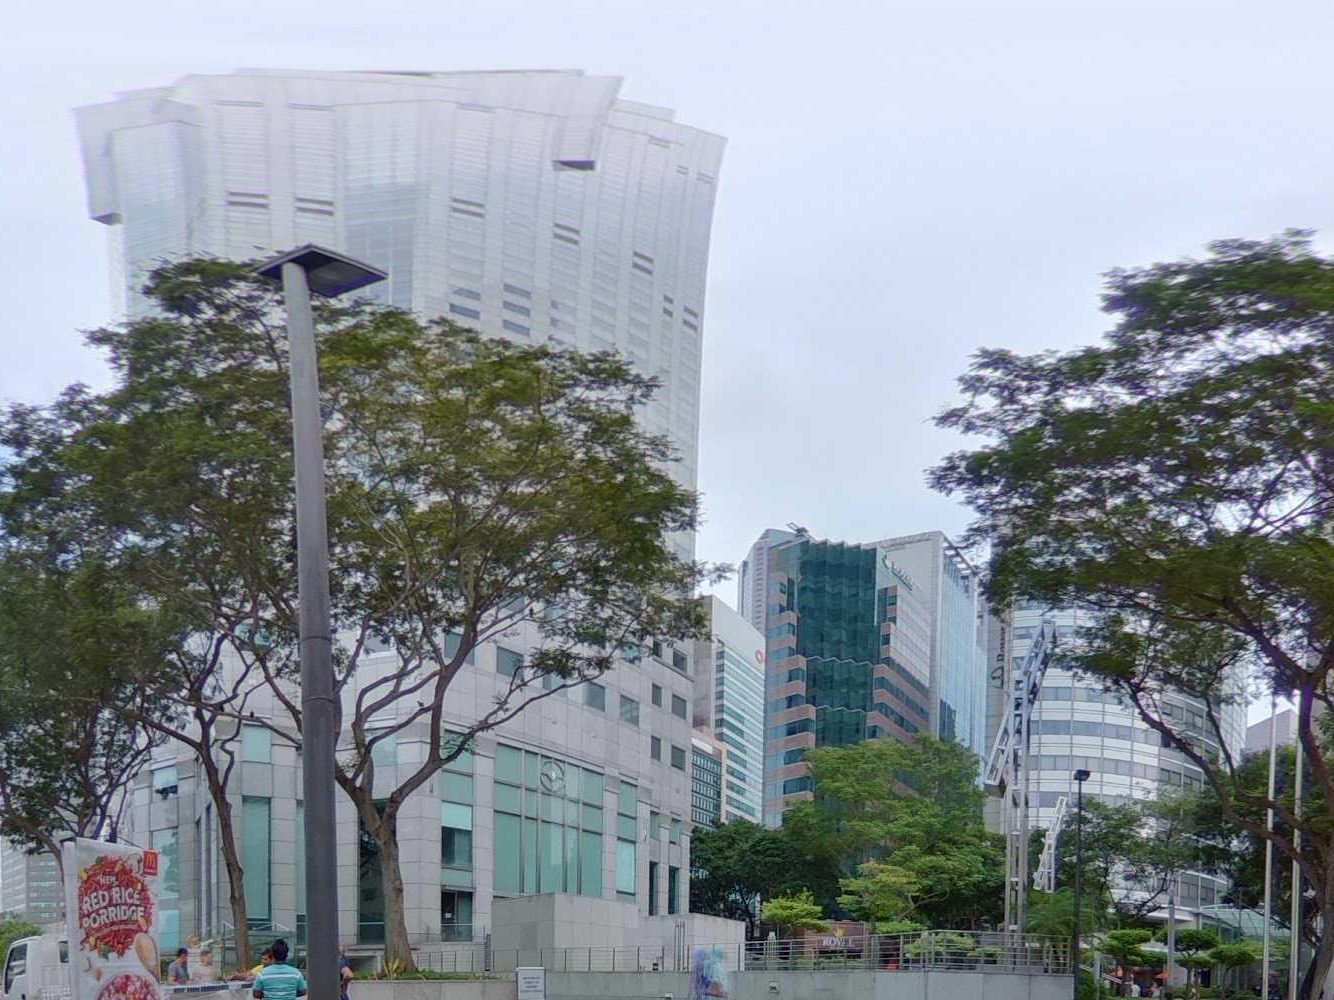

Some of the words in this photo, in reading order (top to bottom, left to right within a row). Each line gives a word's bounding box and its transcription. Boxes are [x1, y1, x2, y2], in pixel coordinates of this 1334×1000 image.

[82, 889, 110, 913] RED
[112, 886, 141, 904] RICE
[82, 905, 145, 928] PORRIDGE
